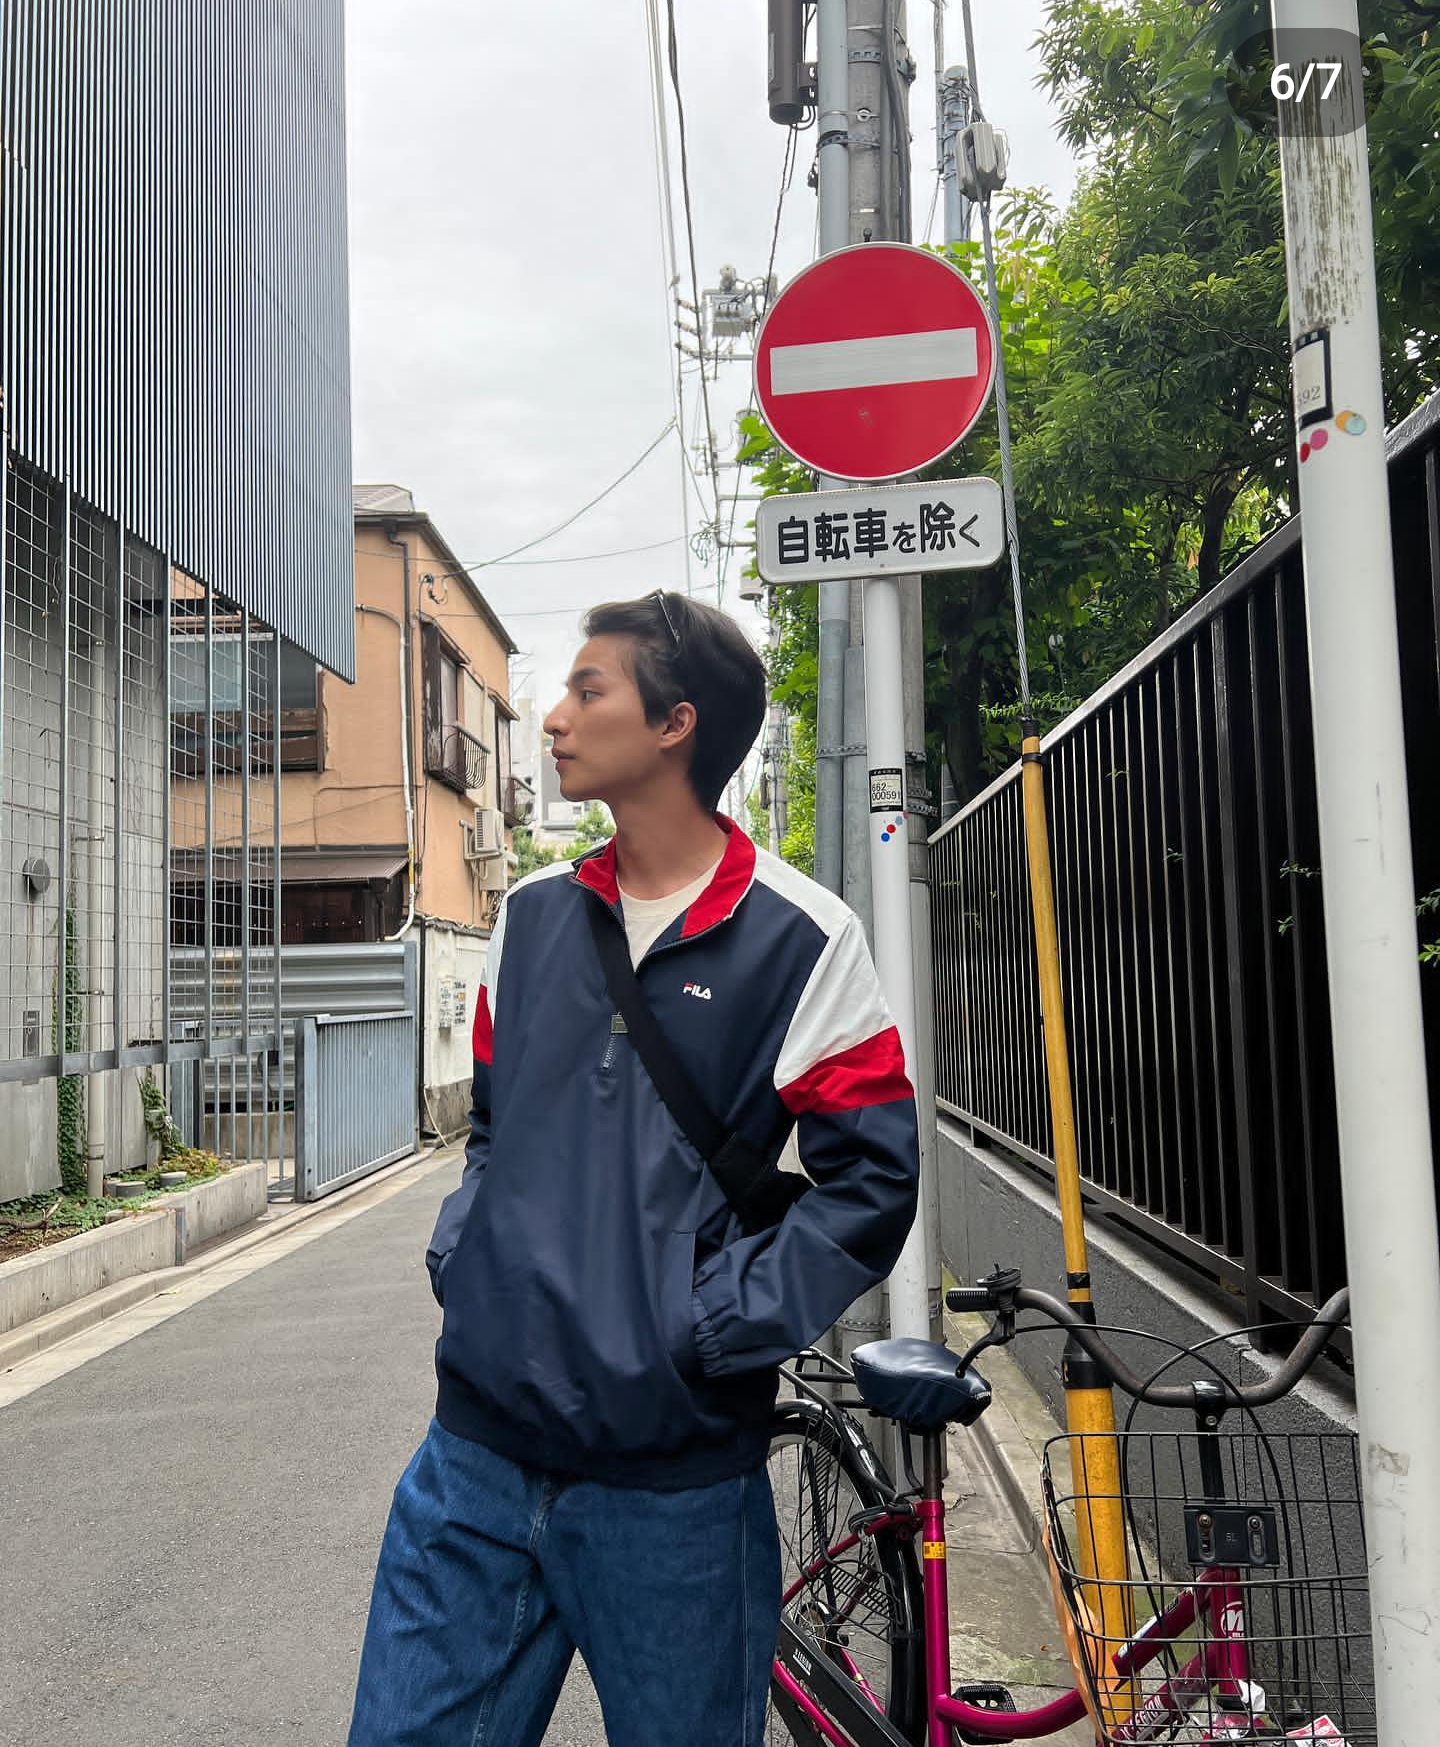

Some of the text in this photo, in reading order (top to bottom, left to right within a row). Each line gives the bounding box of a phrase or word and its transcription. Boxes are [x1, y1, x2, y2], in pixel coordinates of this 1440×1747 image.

[777, 500, 981, 565] 自転車を除く
[683, 982, 712, 1000] FILA
